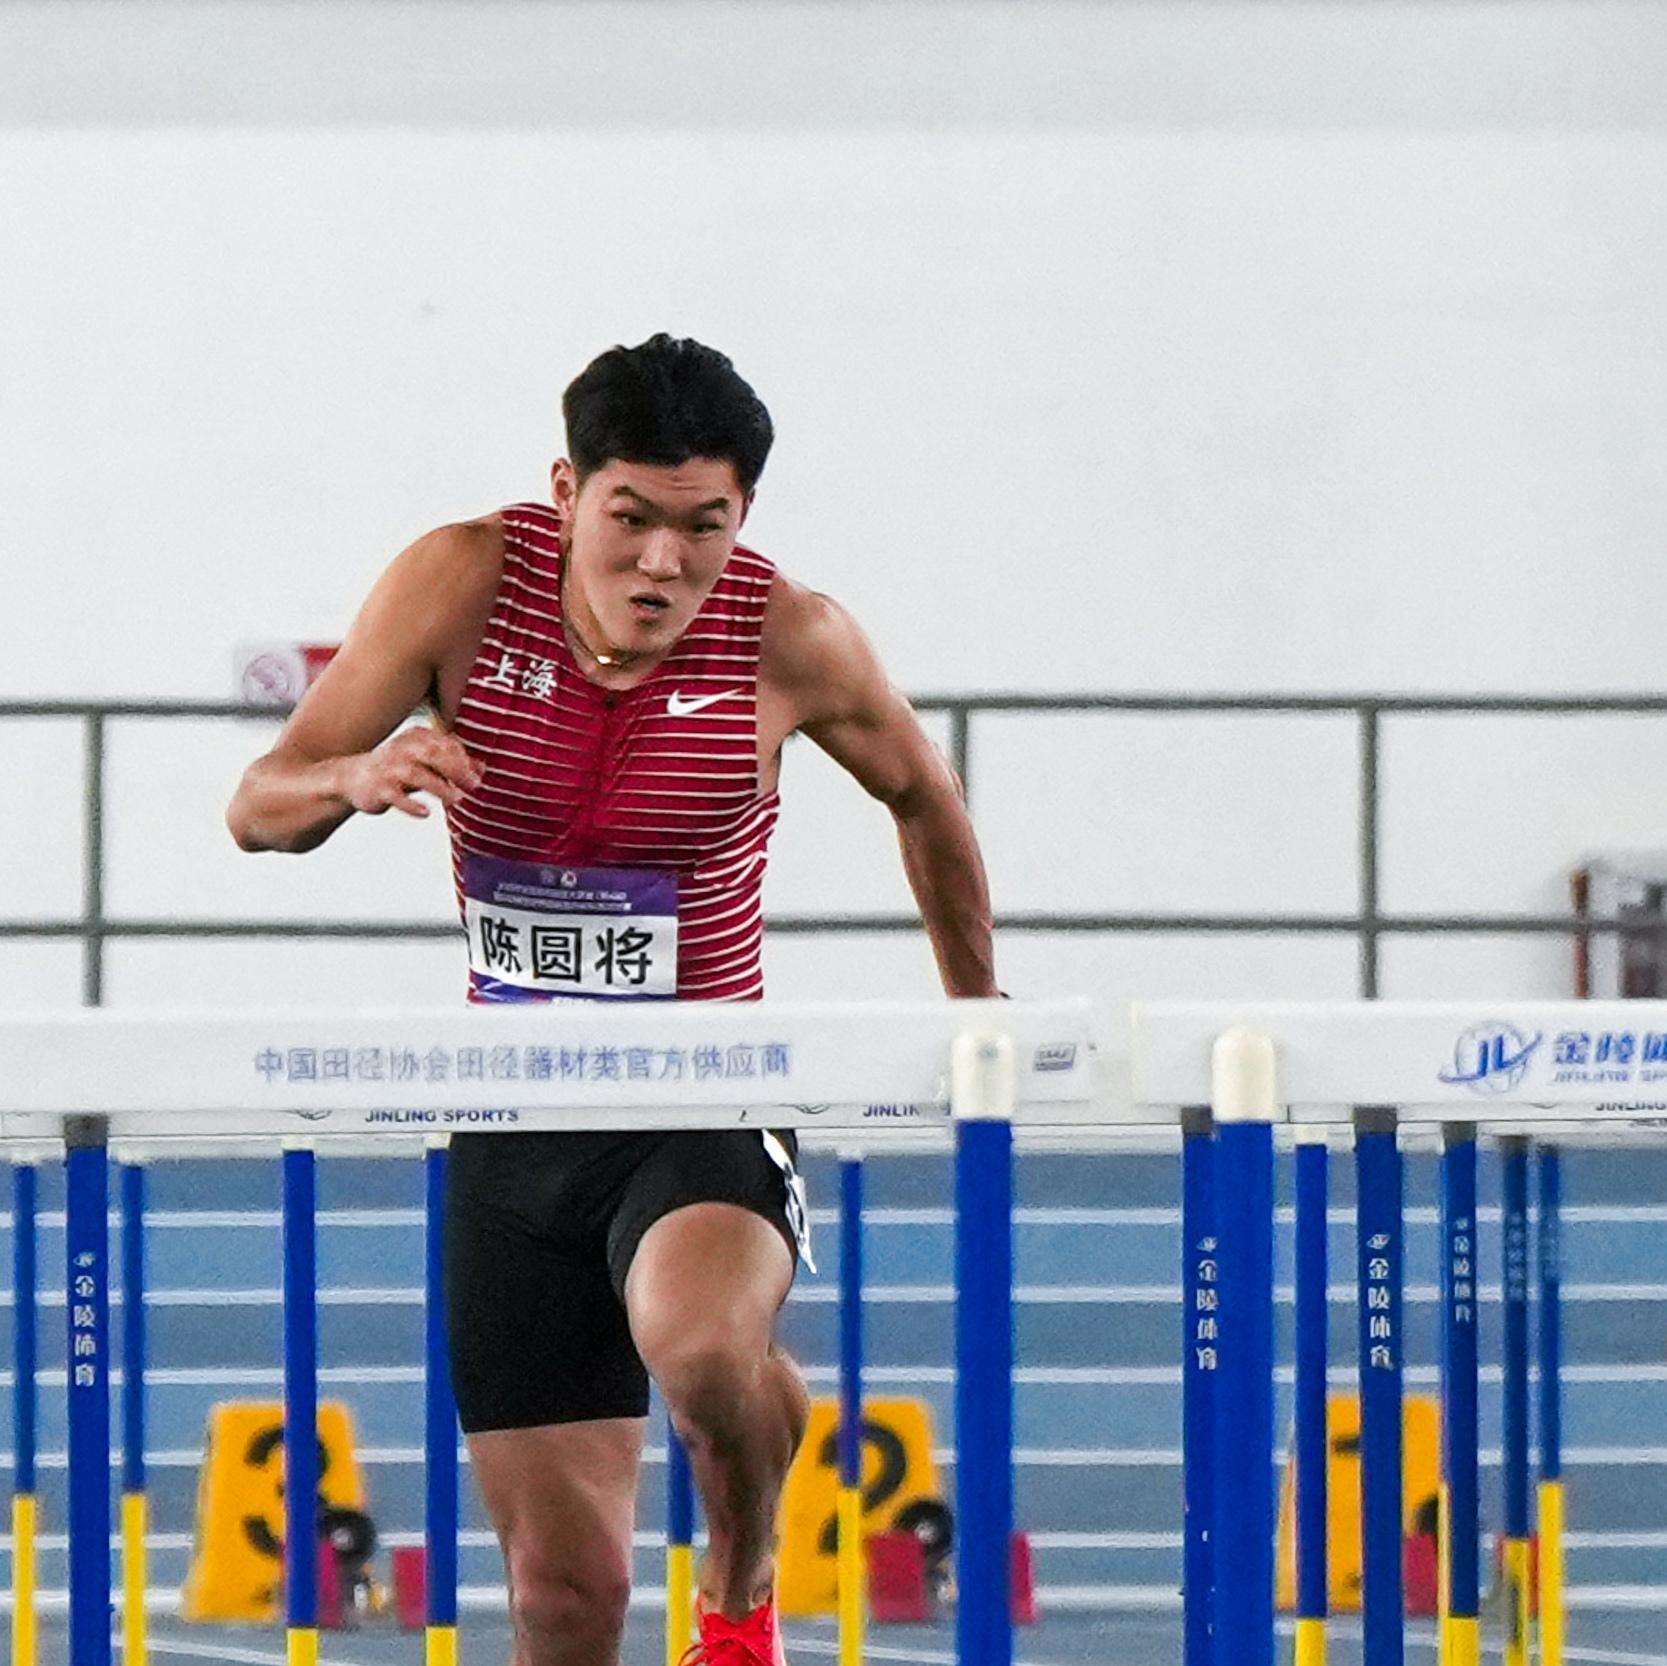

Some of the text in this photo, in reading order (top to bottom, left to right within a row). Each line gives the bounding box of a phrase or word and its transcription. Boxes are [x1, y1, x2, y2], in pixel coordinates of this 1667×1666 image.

[481, 653, 557, 699] 上海
[479, 915, 654, 986] 陈圆将
[254, 1042, 794, 1083] 中国田径协会田径器材类官方供应商
[365, 1108, 519, 1123] JINLING SPORTS
